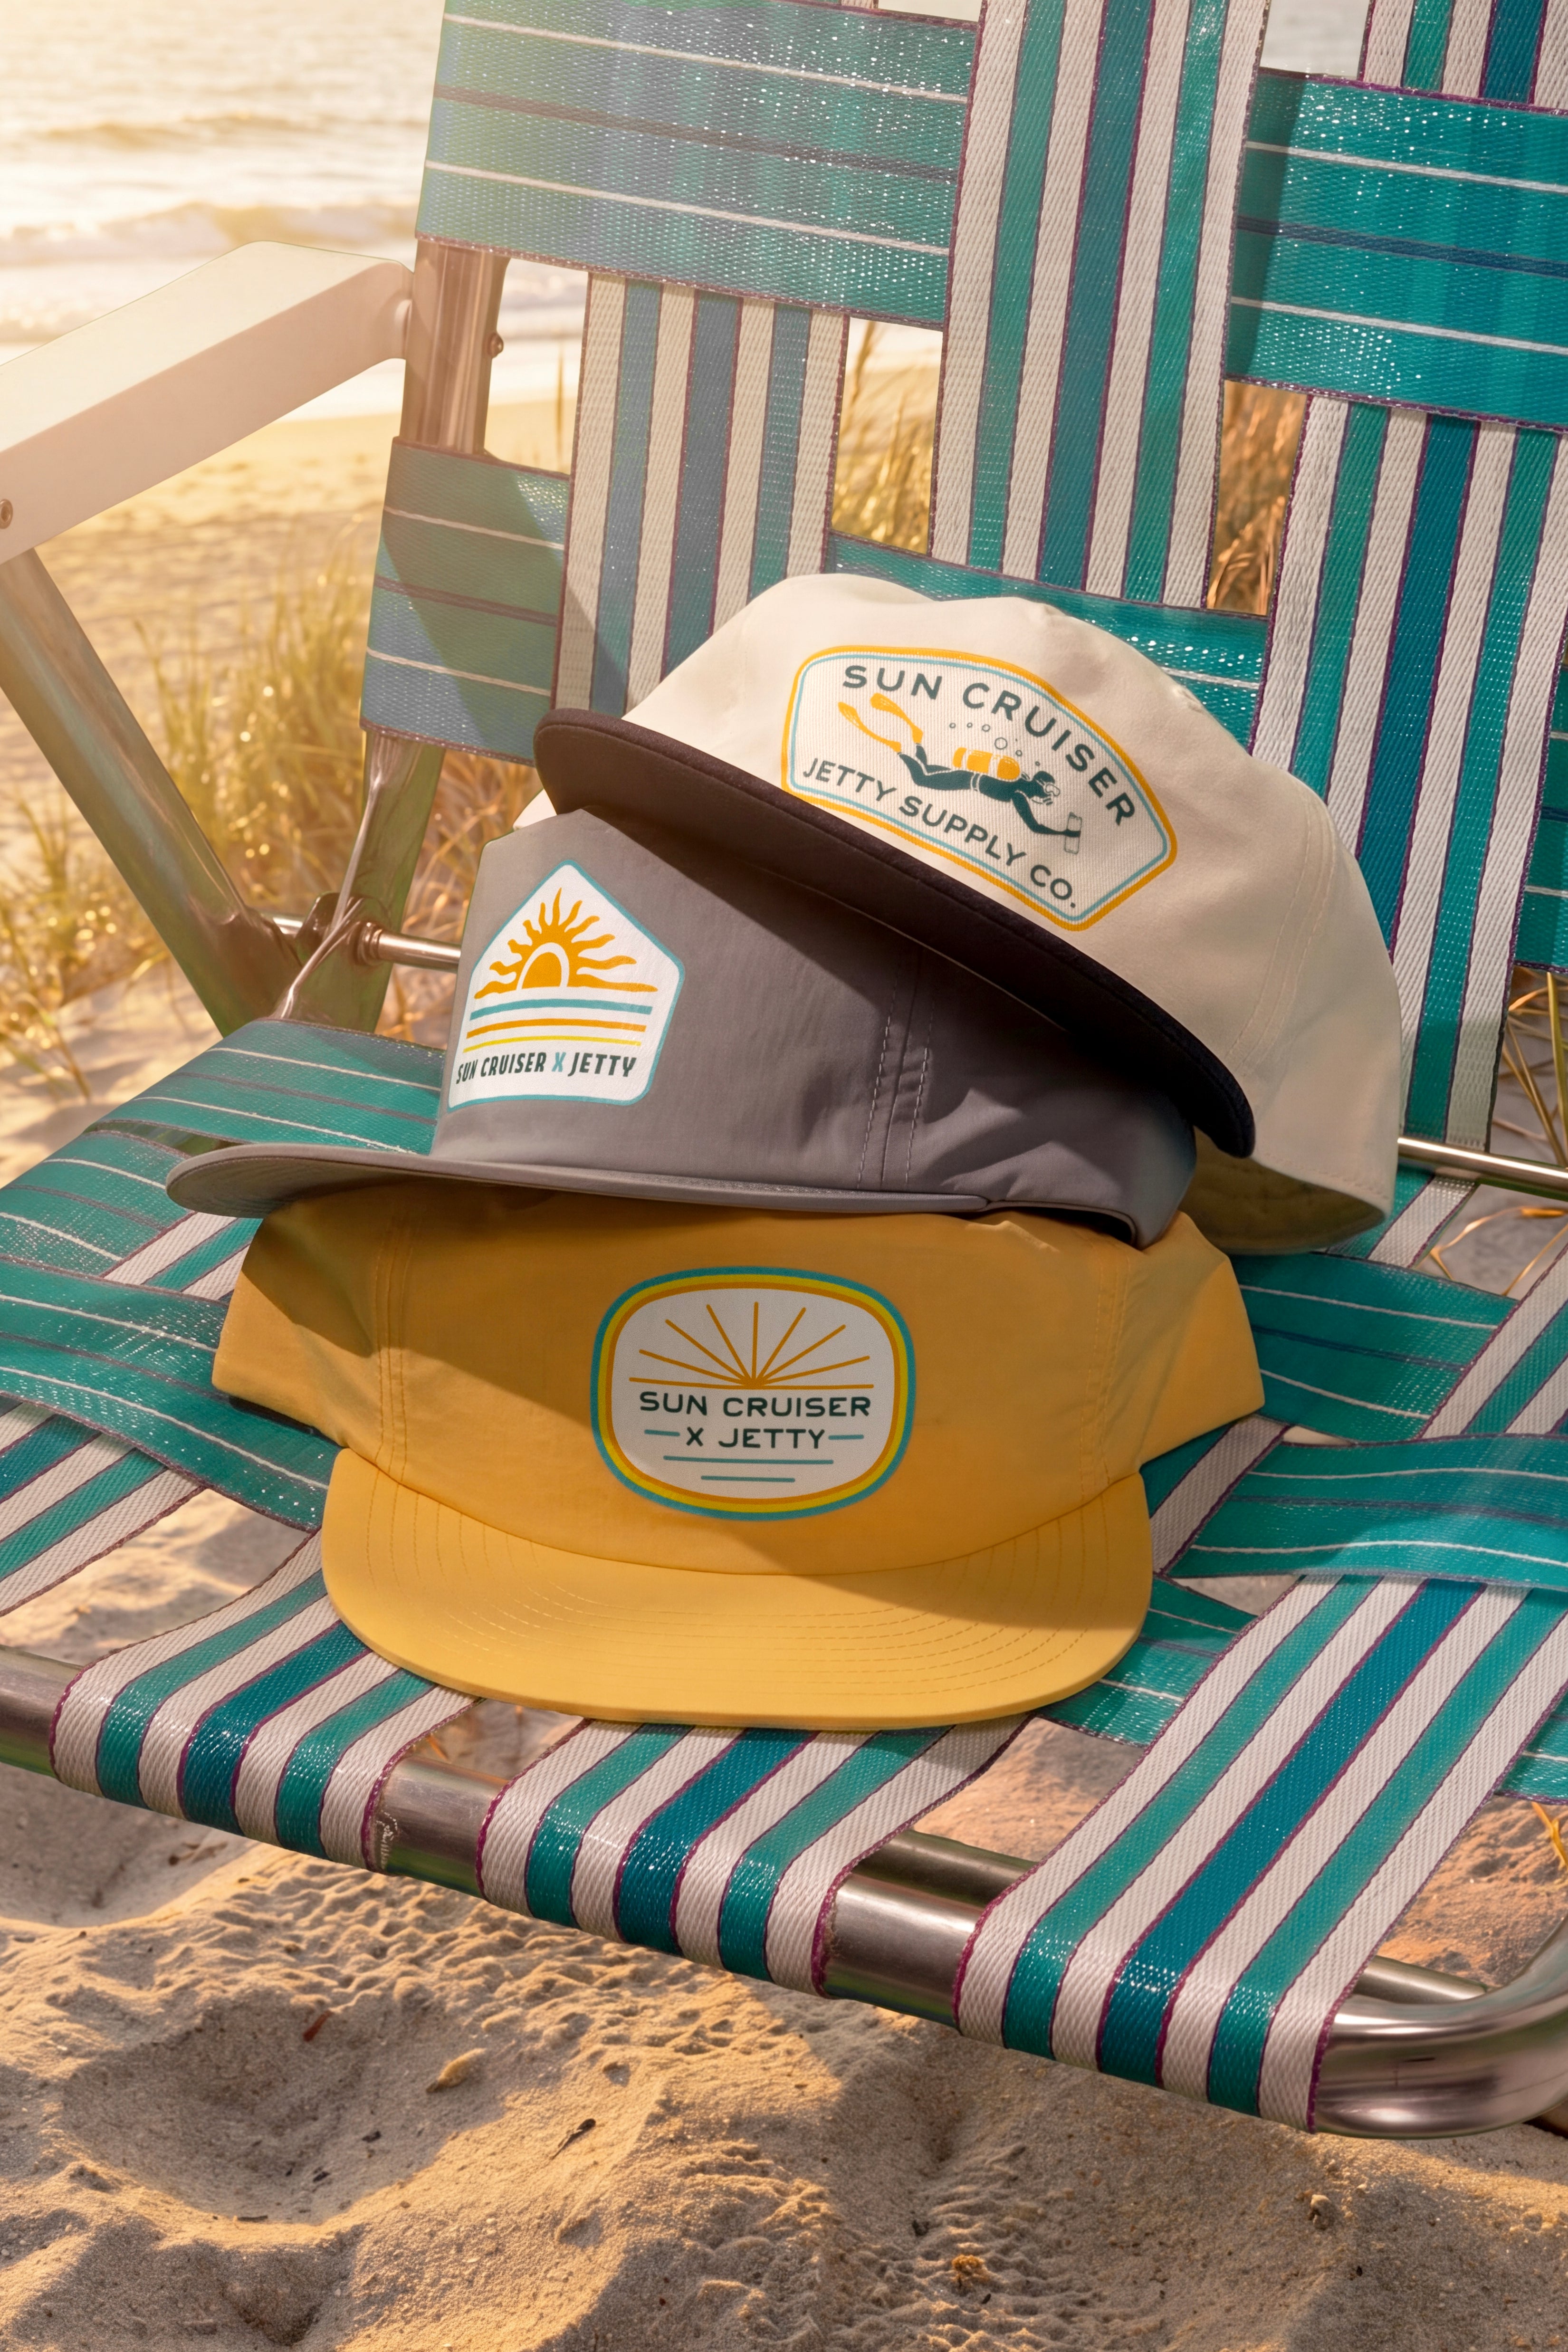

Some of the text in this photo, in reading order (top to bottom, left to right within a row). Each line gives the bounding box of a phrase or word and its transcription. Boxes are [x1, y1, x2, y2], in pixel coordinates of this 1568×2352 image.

[842, 665, 1135, 825] SUN CRUISER
[803, 757, 1077, 908] JETTY SUPPLY CO.
[456, 1052, 637, 1084] SUN CRUISER X JETTY
[639, 1391, 871, 1417] SUN CRUISER
[686, 1426, 825, 1449] X JETTY
